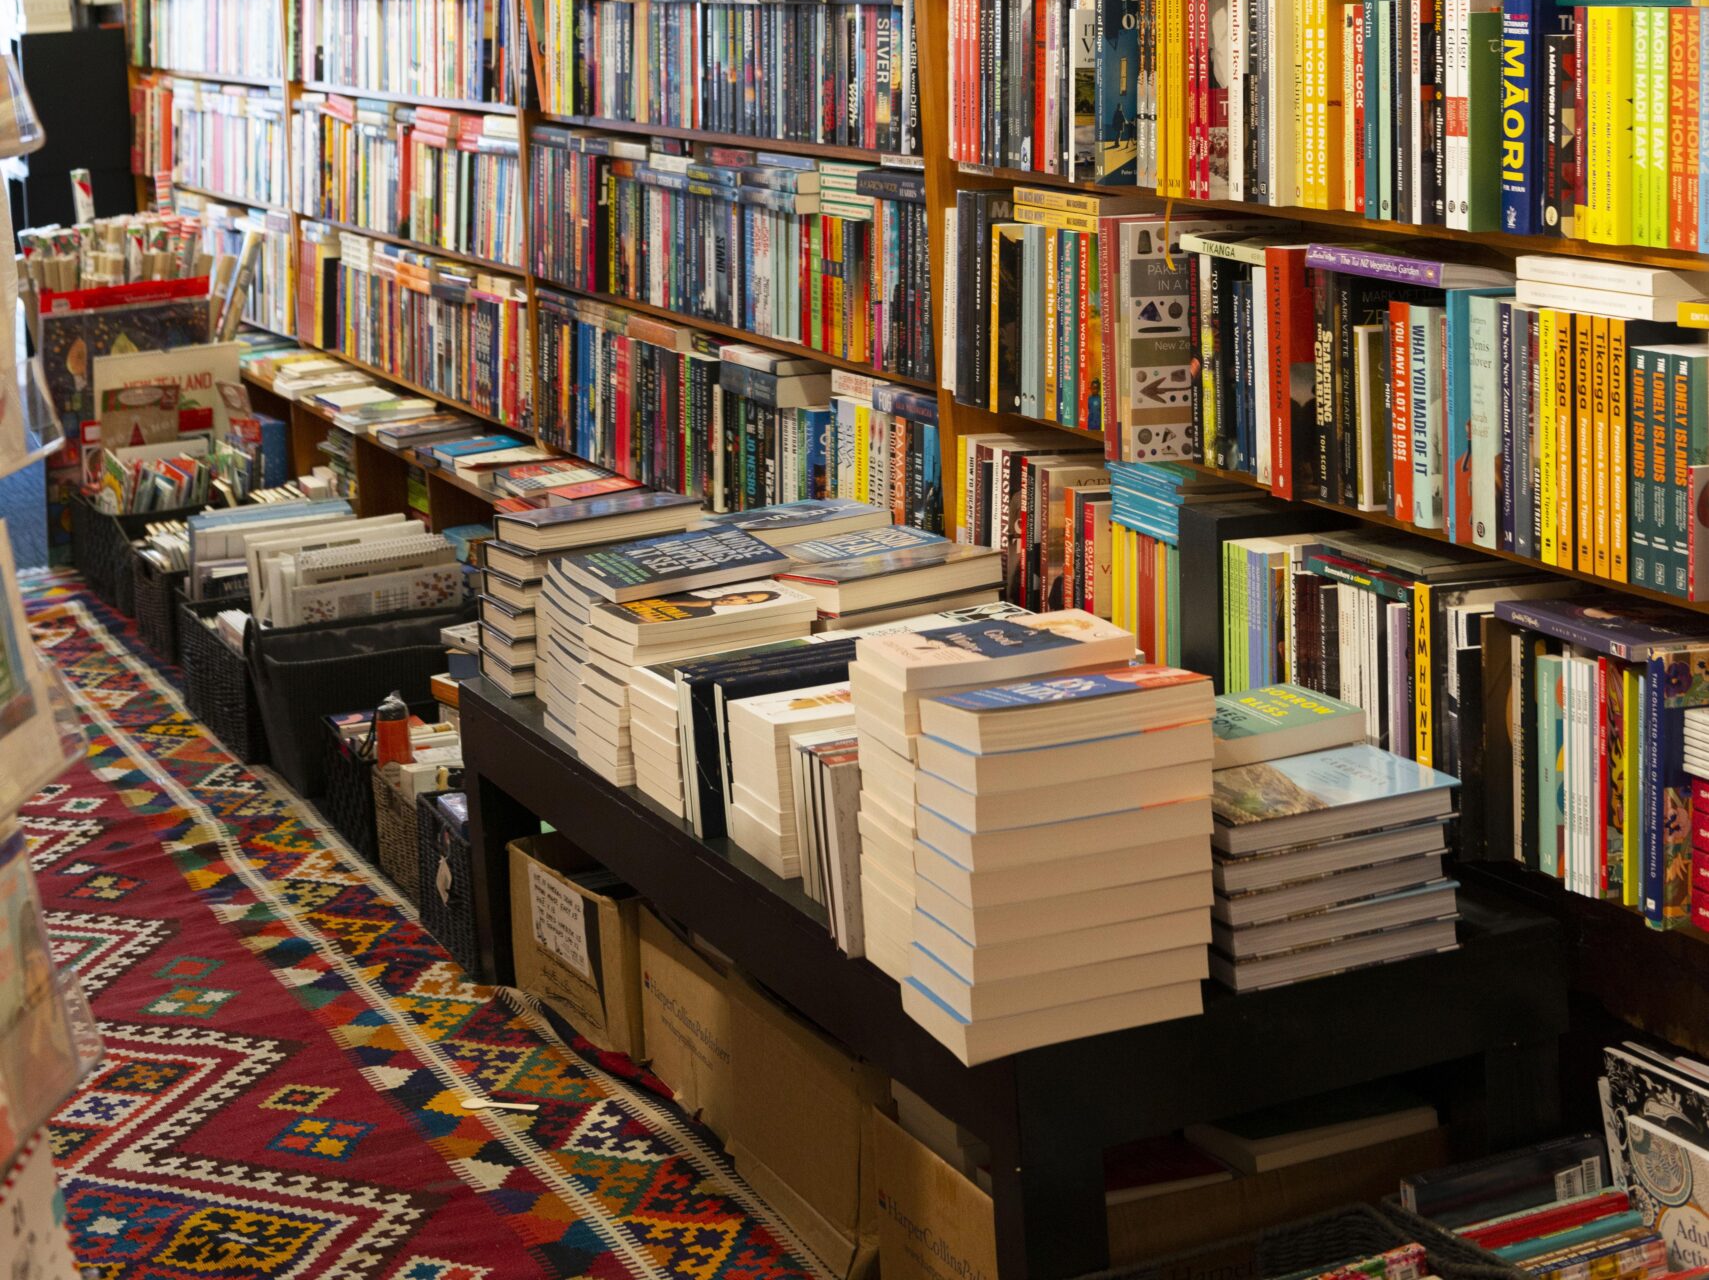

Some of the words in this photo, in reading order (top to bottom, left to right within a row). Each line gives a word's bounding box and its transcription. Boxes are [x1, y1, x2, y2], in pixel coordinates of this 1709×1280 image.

[1097, 16, 1104, 25] of
[1355, 18, 1363, 52] STOP
[1365, 2, 1373, 38] Swim
[877, 19, 889, 83] SILVER
[1096, 28, 1104, 52] Hope
[1636, 12, 1649, 70] MĀORI
[1654, 12, 1667, 70] MĀORI
[1671, 14, 1685, 80] MĀORI
[1232, 56, 1240, 81] Best
[1356, 63, 1364, 107] CLOCK
[1503, 39, 1529, 182] MĀORI
[1636, 74, 1647, 121] MADE
[1654, 75, 1664, 122] MADE
[1672, 83, 1683, 109] AT
[1306, 103, 1314, 184] BURNOUT
[1635, 127, 1646, 168] EASY
[1653, 128, 1664, 170] EASY
[1672, 119, 1683, 172] HOME
[1202, 241, 1235, 257] TIKANGA
[1340, 255, 1350, 265] The
[1360, 258, 1370, 268] NZ
[1370, 259, 1397, 273] Vegetable
[1398, 263, 1420, 276] Garden
[1047, 293, 1055, 314] the
[1047, 317, 1055, 377] Mountain
[1397, 347, 1405, 375] HAVE
[1413, 325, 1425, 359] WHAT
[1315, 341, 1324, 426] CHARLIE
[1323, 331, 1332, 422] SEARCHING
[1397, 380, 1405, 388] A
[1413, 363, 1425, 390] YOU
[1558, 327, 1568, 406] Tikanga
[1578, 329, 1588, 410] Tikanga
[1595, 333, 1605, 413] Tikanga
[1612, 336, 1622, 417] Tikanga
[1657, 358, 1665, 372] THE
[1679, 361, 1687, 375] THE
[1397, 392, 1406, 412] LOT
[1633, 369, 1644, 417] LONELY
[1653, 372, 1665, 420] LONELY
[1675, 375, 1687, 423] LONELY
[1398, 417, 1406, 431] TO
[1413, 399, 1426, 436] MADE
[747, 435, 755, 453] JO
[1398, 435, 1406, 461] LOSE
[1415, 440, 1427, 457] OF
[1634, 422, 1644, 477] ISLANDS
[1654, 425, 1665, 482] ISLANDS
[1675, 429, 1687, 486] ISLANDS
[747, 456, 756, 495] NESBO
[895, 424, 904, 510] DAMAGE
[1416, 462, 1427, 476] IT
[1002, 456, 1010, 547] CROSSING
[625, 548, 661, 559] AT
[652, 540, 719, 569] HAPPEN
[684, 536, 744, 563] THINGS
[712, 530, 774, 558] WORSE
[642, 556, 686, 574] SEA
[1417, 595, 1428, 657] SAM
[1241, 698, 1289, 718] BLISS
[1260, 686, 1335, 715] SORROW
[1418, 664, 1427, 752] HUNT
[1651, 771, 1657, 782] OF
